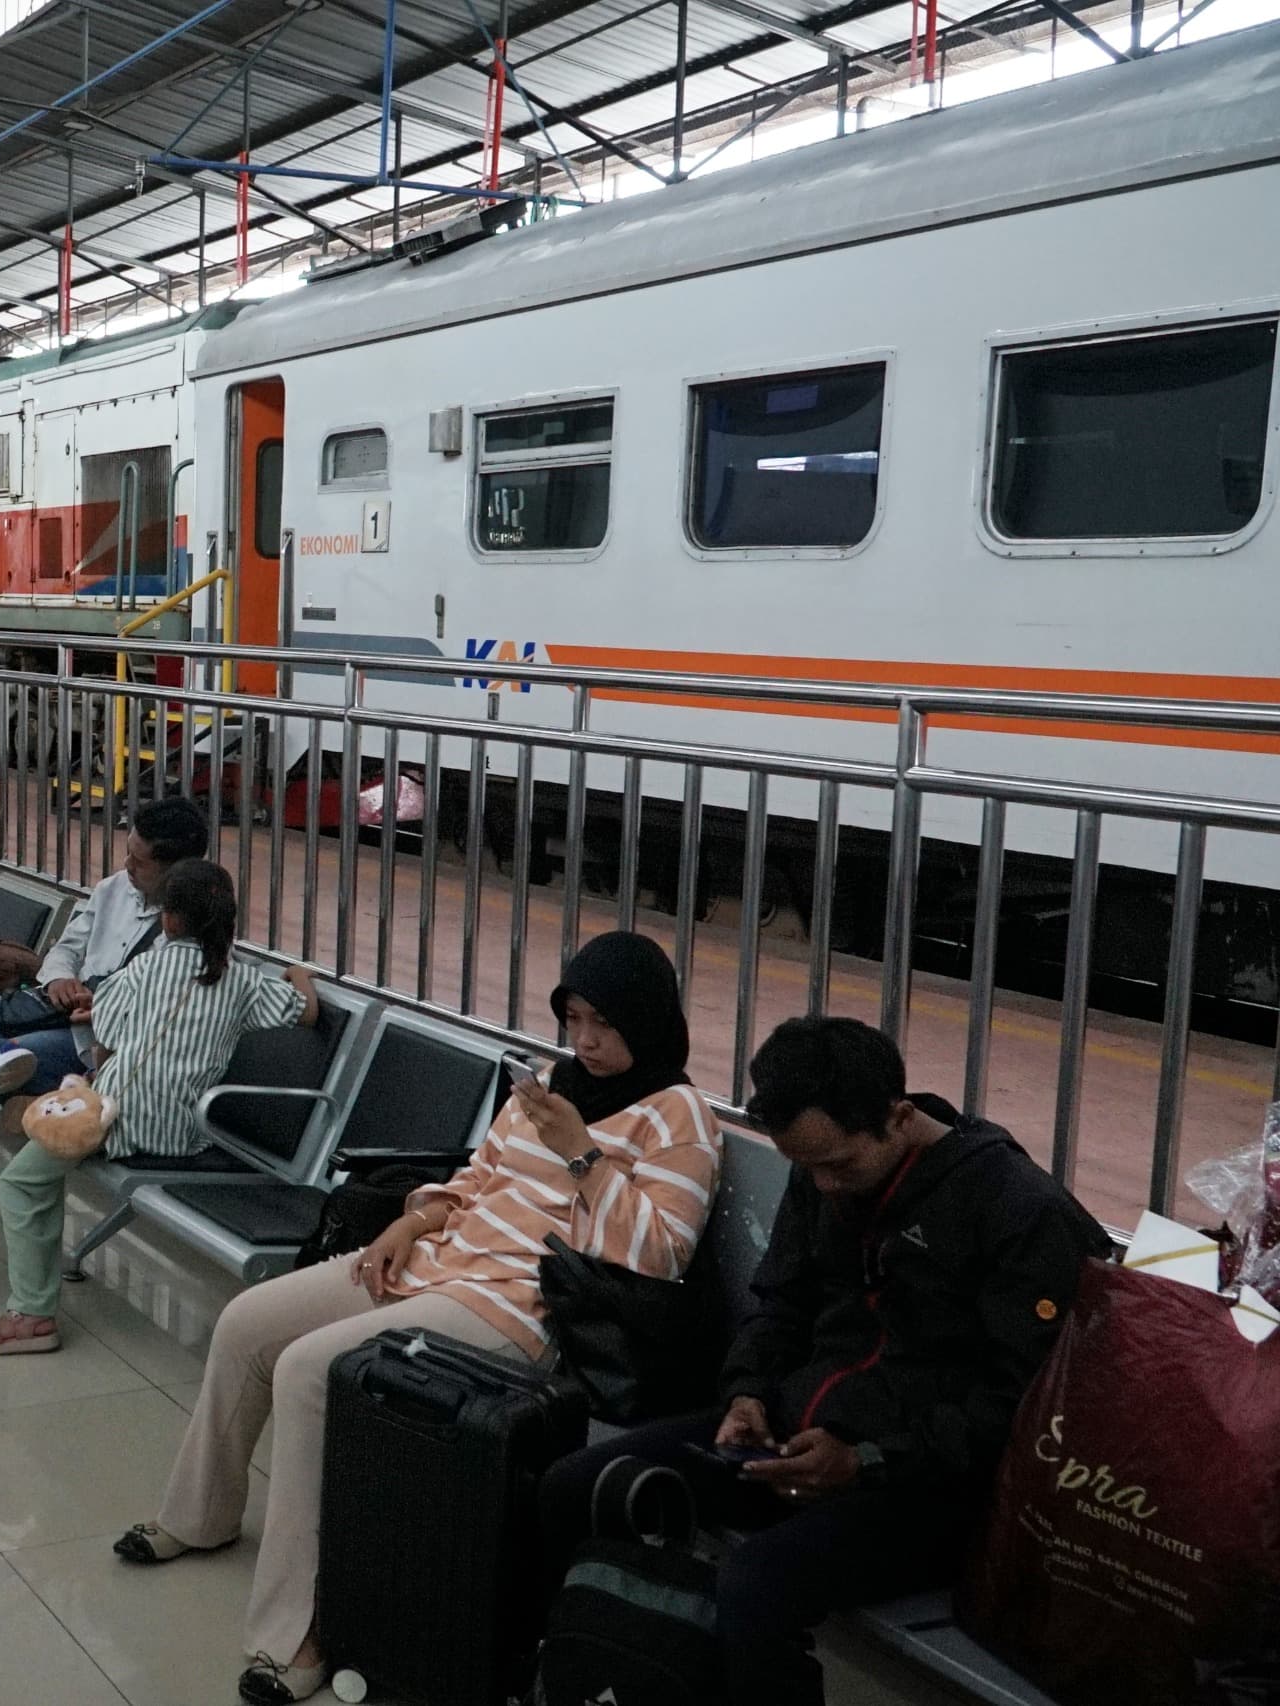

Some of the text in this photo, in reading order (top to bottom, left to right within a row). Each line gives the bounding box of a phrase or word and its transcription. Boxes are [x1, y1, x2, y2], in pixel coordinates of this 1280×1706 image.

[300, 534, 359, 555] EKONOMI
[370, 511, 379, 539] 1
[463, 638, 536, 693] KAI
[1076, 1499, 1141, 1537] FASHION
[1145, 1528, 1203, 1562] TEXTILE
